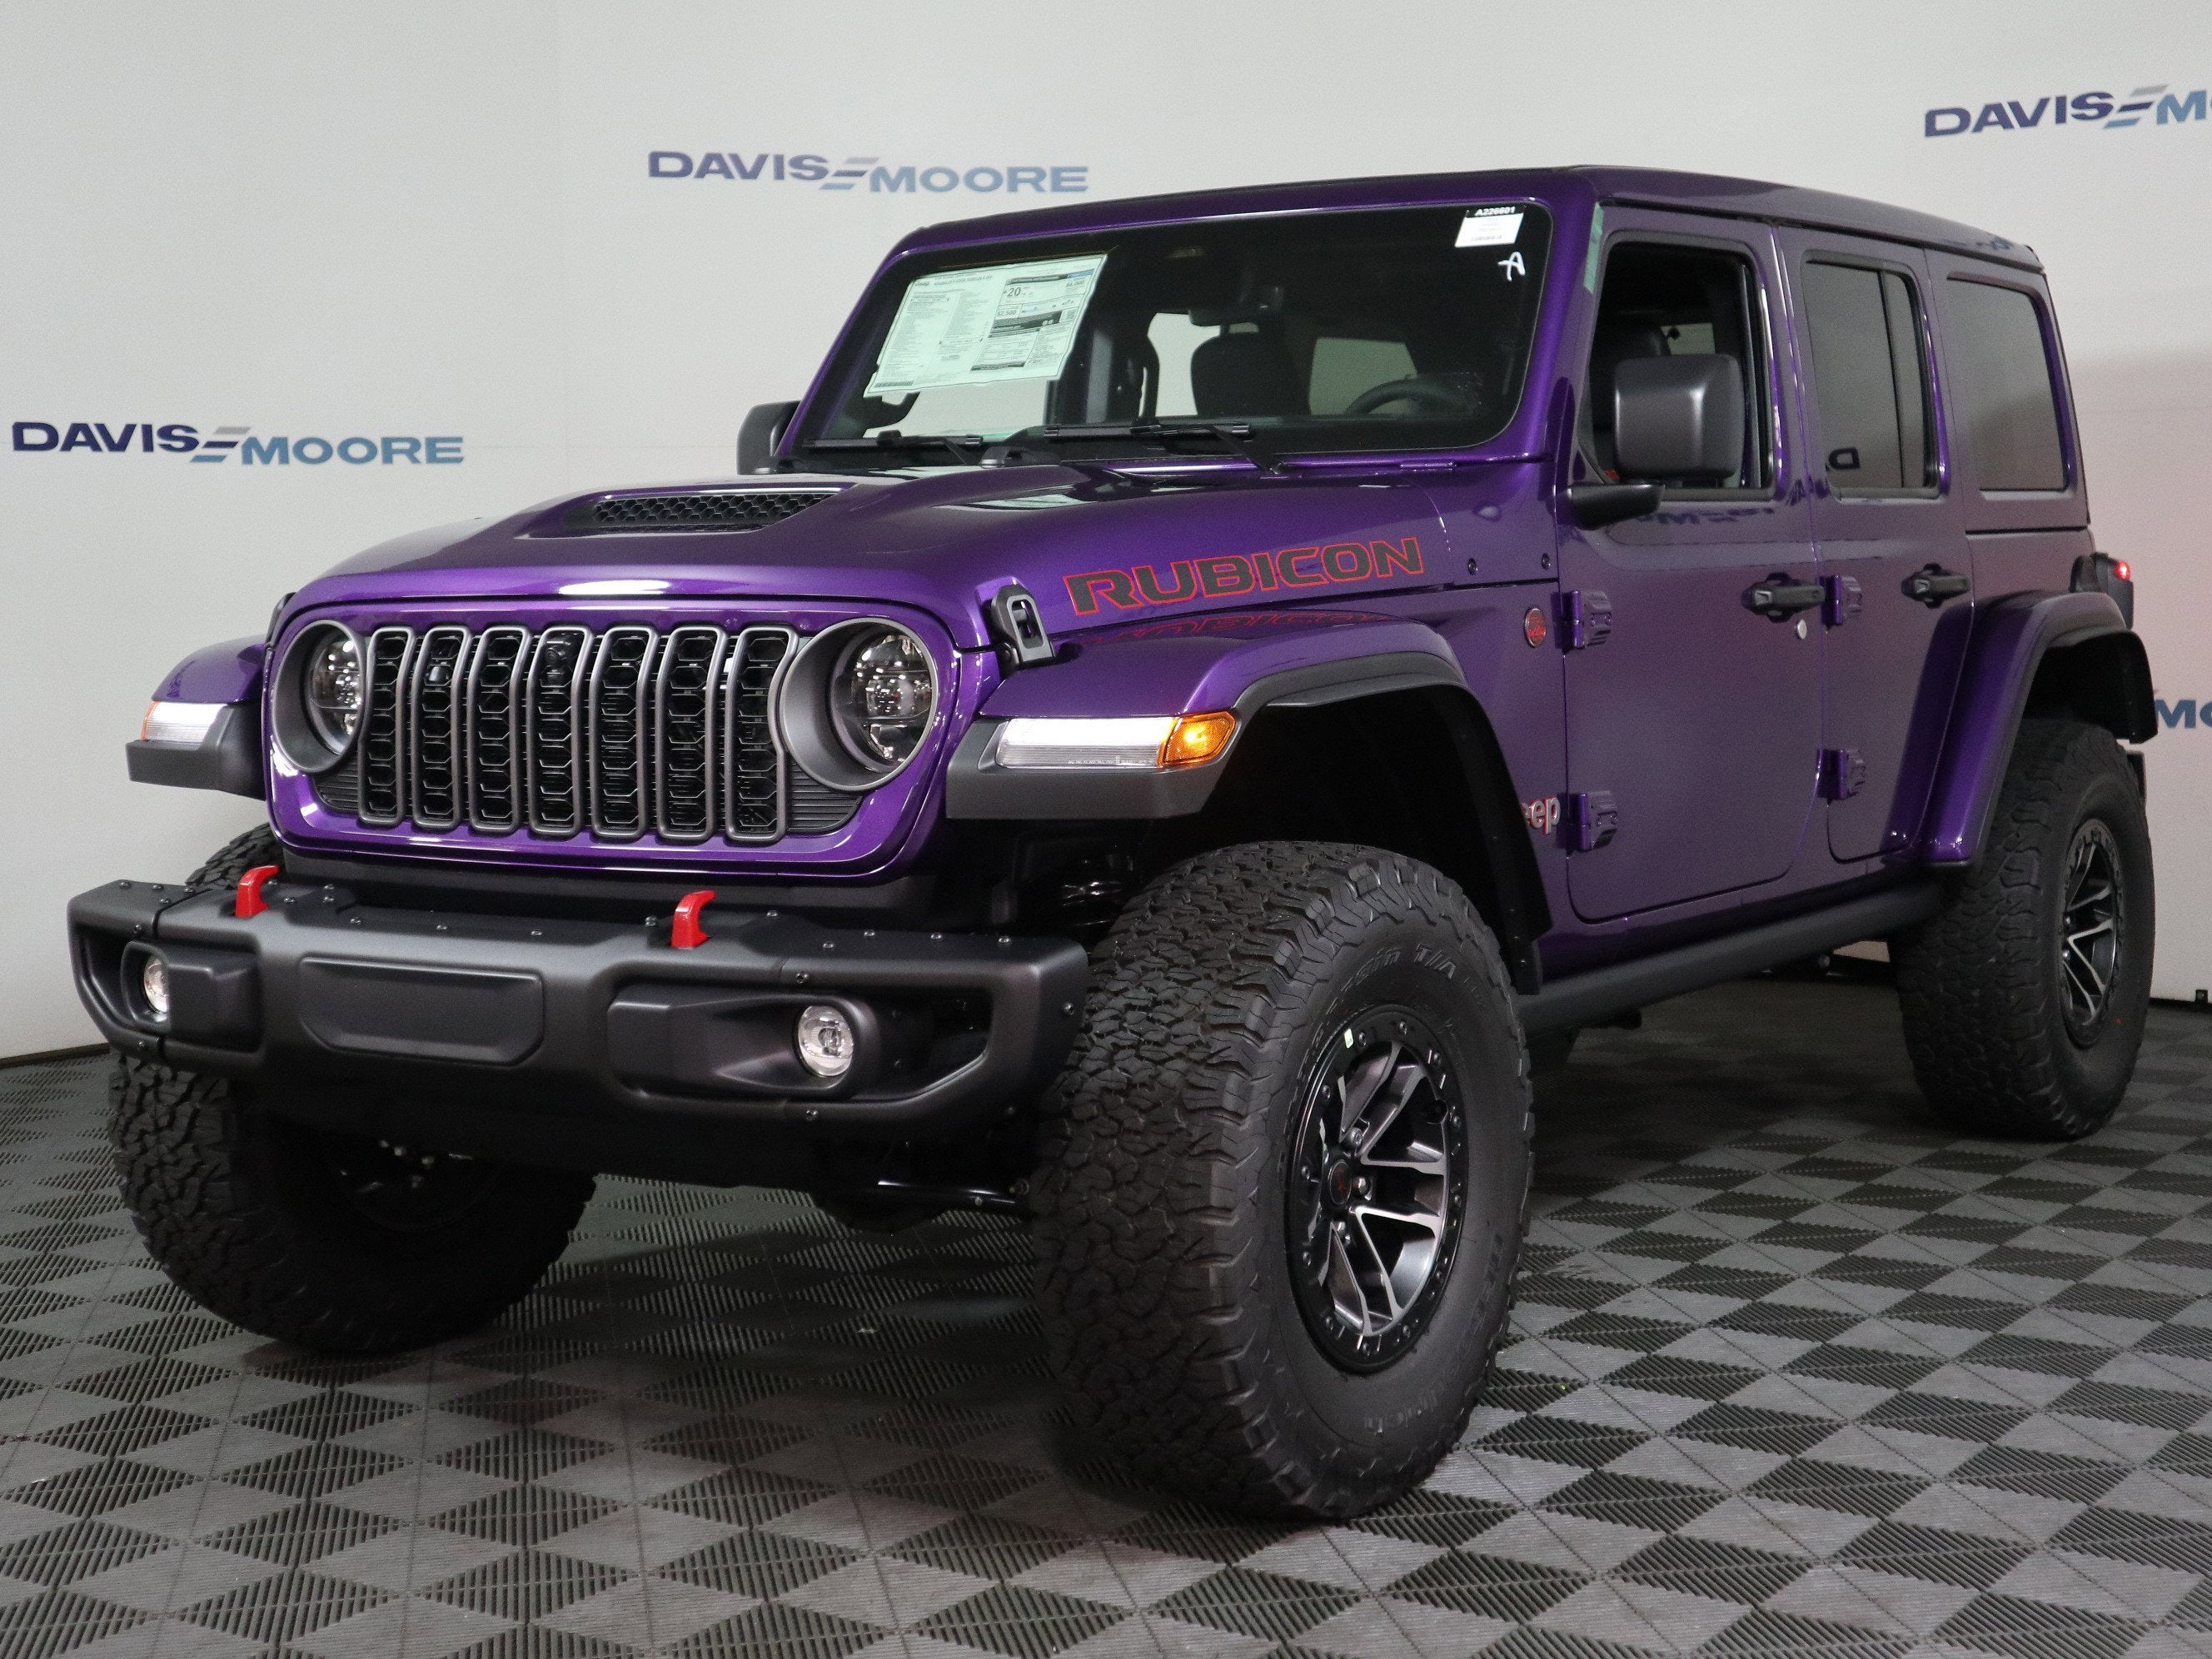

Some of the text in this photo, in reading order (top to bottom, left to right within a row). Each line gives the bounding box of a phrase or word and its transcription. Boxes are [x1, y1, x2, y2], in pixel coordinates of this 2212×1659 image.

[1925, 89, 2212, 137] DAVIS M
[648, 151, 1089, 193] DAVIS MOORE
[1498, 251, 1526, 281] A
[12, 421, 464, 465] DAVIS MOORE
[1063, 536, 1423, 615] RUBICON
[2154, 699, 2212, 729] M
